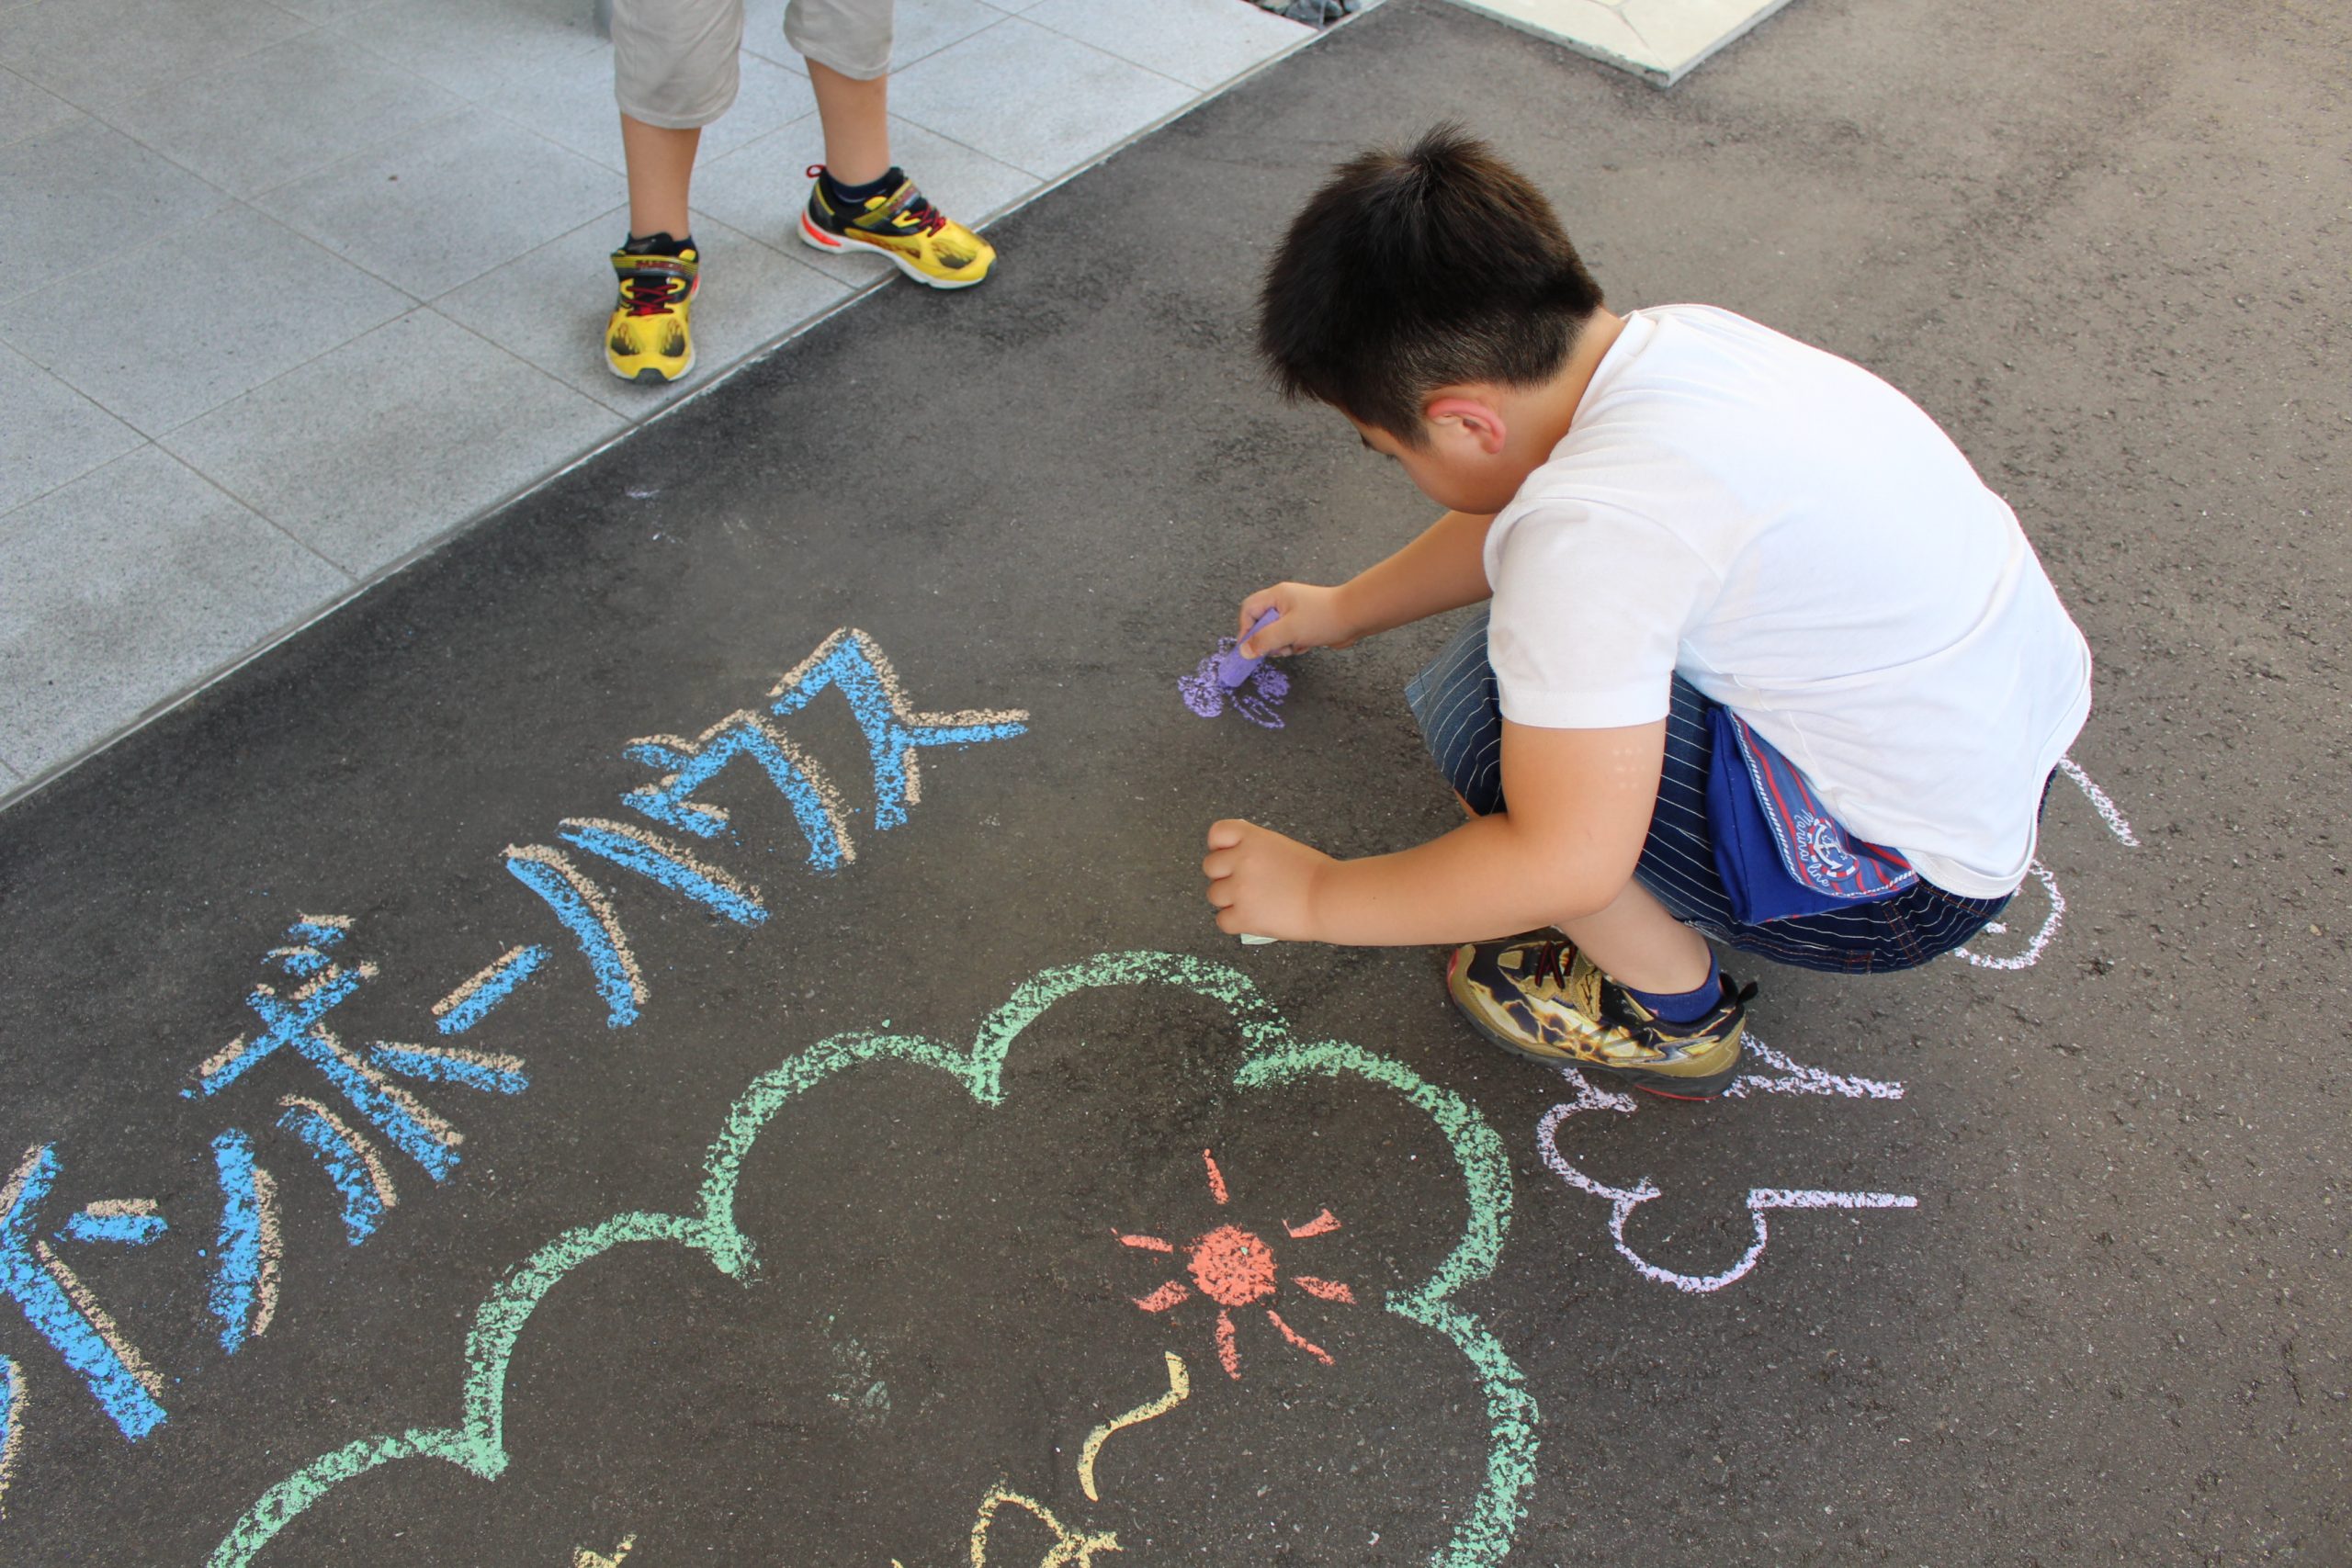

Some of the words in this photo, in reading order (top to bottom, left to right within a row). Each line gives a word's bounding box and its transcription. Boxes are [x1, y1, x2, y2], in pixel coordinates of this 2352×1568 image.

[0, 627, 1030, 1479] インボーハウス
[1792, 808, 1815, 862] Marina
[1806, 863, 1830, 887] line
